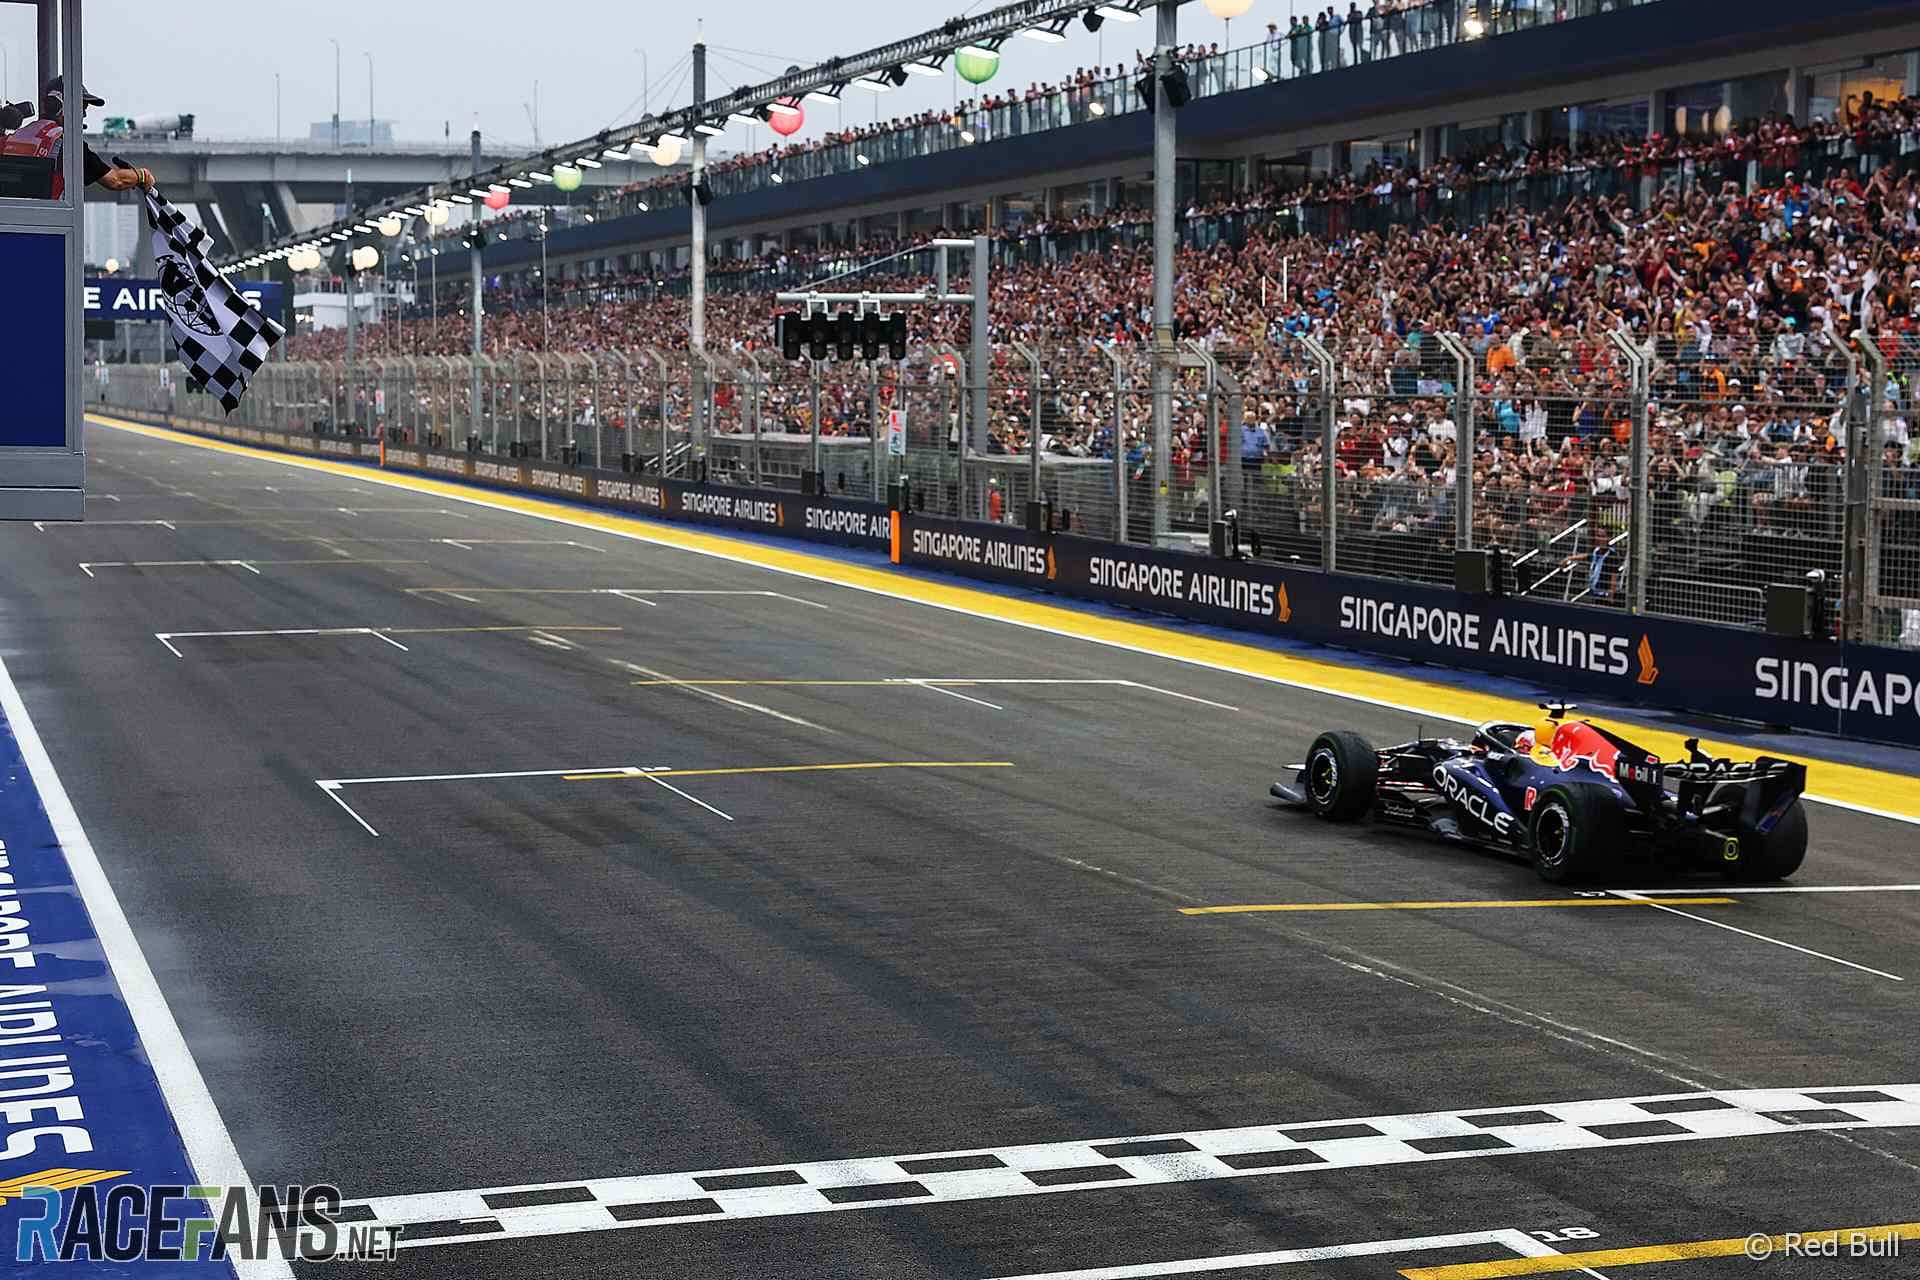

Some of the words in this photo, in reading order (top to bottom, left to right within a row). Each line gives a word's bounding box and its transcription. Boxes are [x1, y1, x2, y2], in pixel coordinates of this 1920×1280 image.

[597, 479, 630, 500] SINGAPORE
[631, 484, 660, 506] AIRLINES
[681, 491, 731, 515] SINGAPORE
[733, 498, 777, 523] AIRLINES
[805, 507, 867, 535] SINGAPORE
[913, 529, 981, 563] SINGAPORE
[984, 542, 1046, 575] AIRLINES
[1089, 556, 1183, 600] SINGAPORE
[1188, 573, 1275, 615] AIRLINES
[1340, 595, 1480, 650] SINGAPORE
[1489, 618, 1629, 676] AIRLINES
[1619, 763, 1649, 783] Mobil
[1432, 765, 1515, 835] ORACLE
